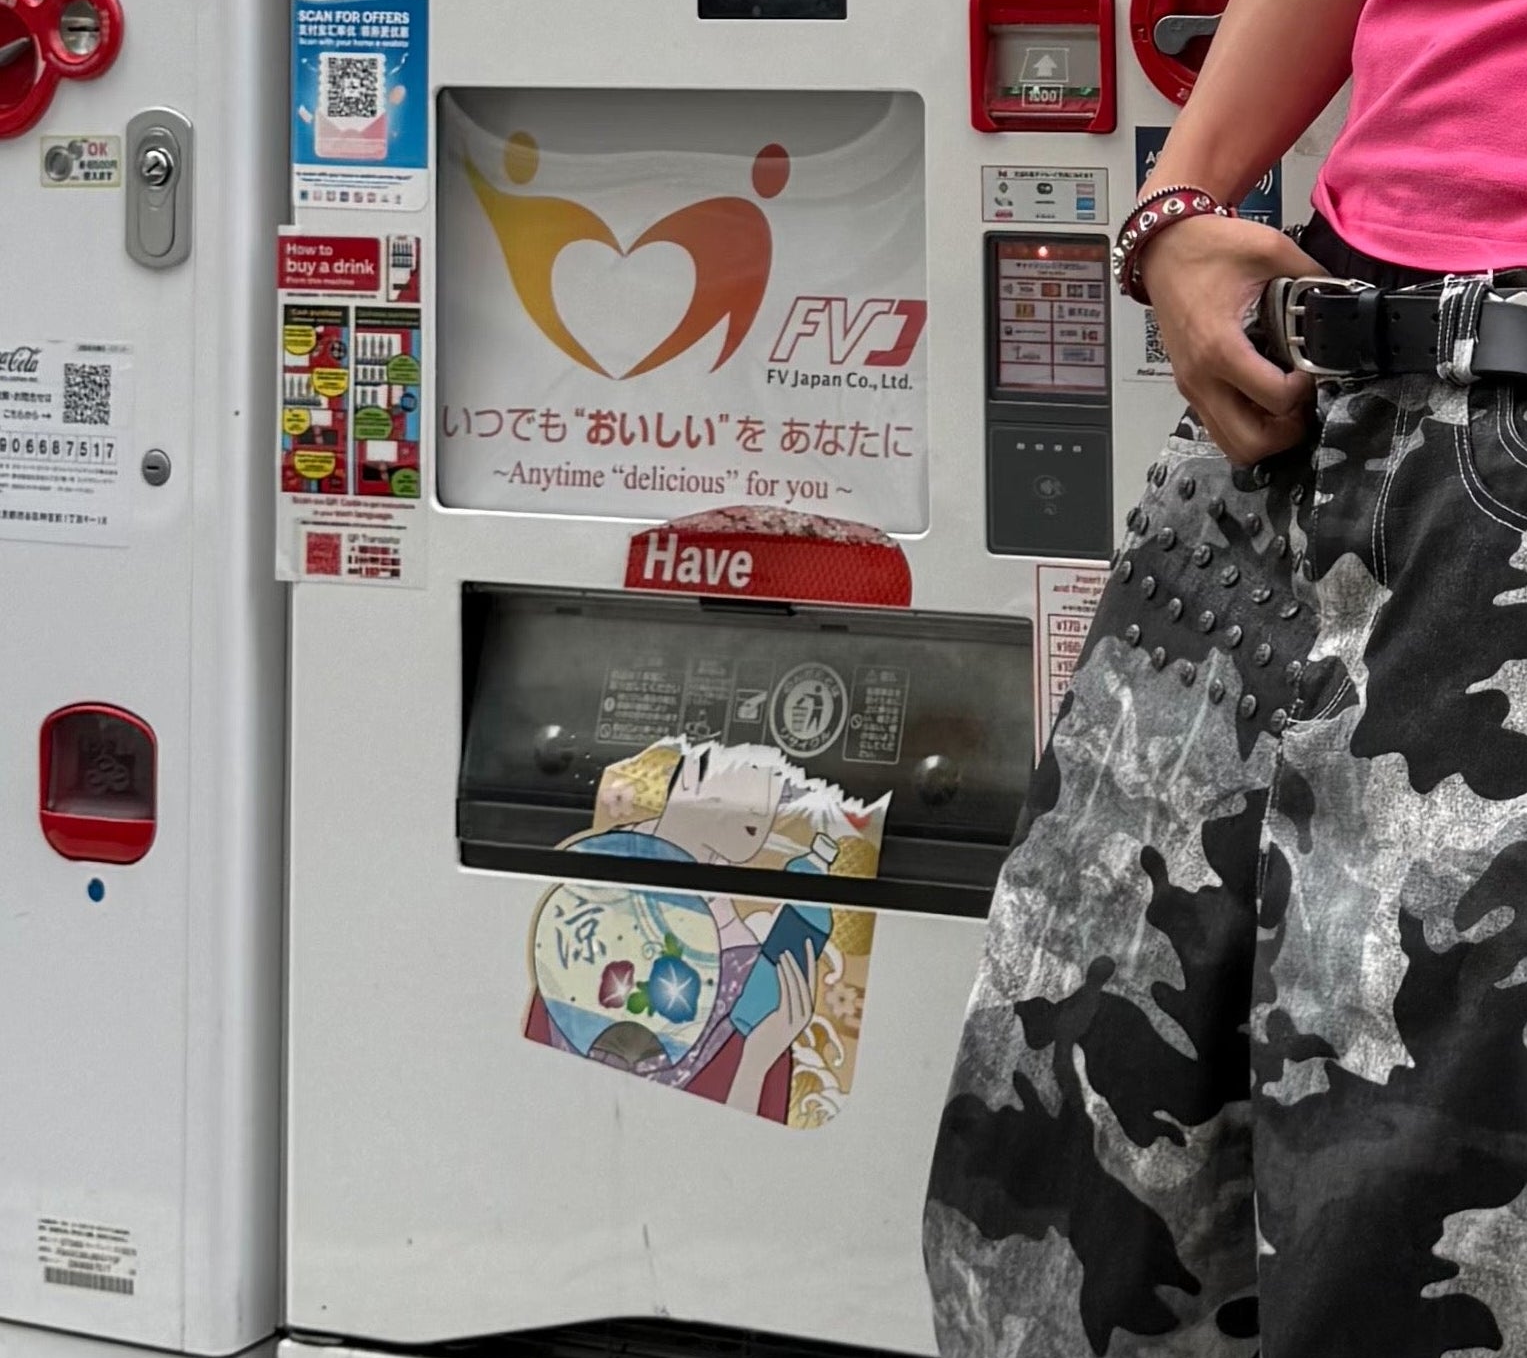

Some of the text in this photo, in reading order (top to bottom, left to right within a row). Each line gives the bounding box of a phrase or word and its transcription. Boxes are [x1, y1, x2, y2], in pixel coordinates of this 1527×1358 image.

[297, 9, 410, 24] SCAN FOR OFFERS
[286, 243, 333, 256] How to
[286, 257, 375, 275] buy a drink
[766, 369, 788, 387] FV
[792, 370, 843, 391] Japan
[880, 372, 914, 391] Ltd.
[780, 418, 914, 458] あなたに
[747, 470, 780, 498] for
[784, 479, 829, 504] you
[642, 532, 754, 588] Have
